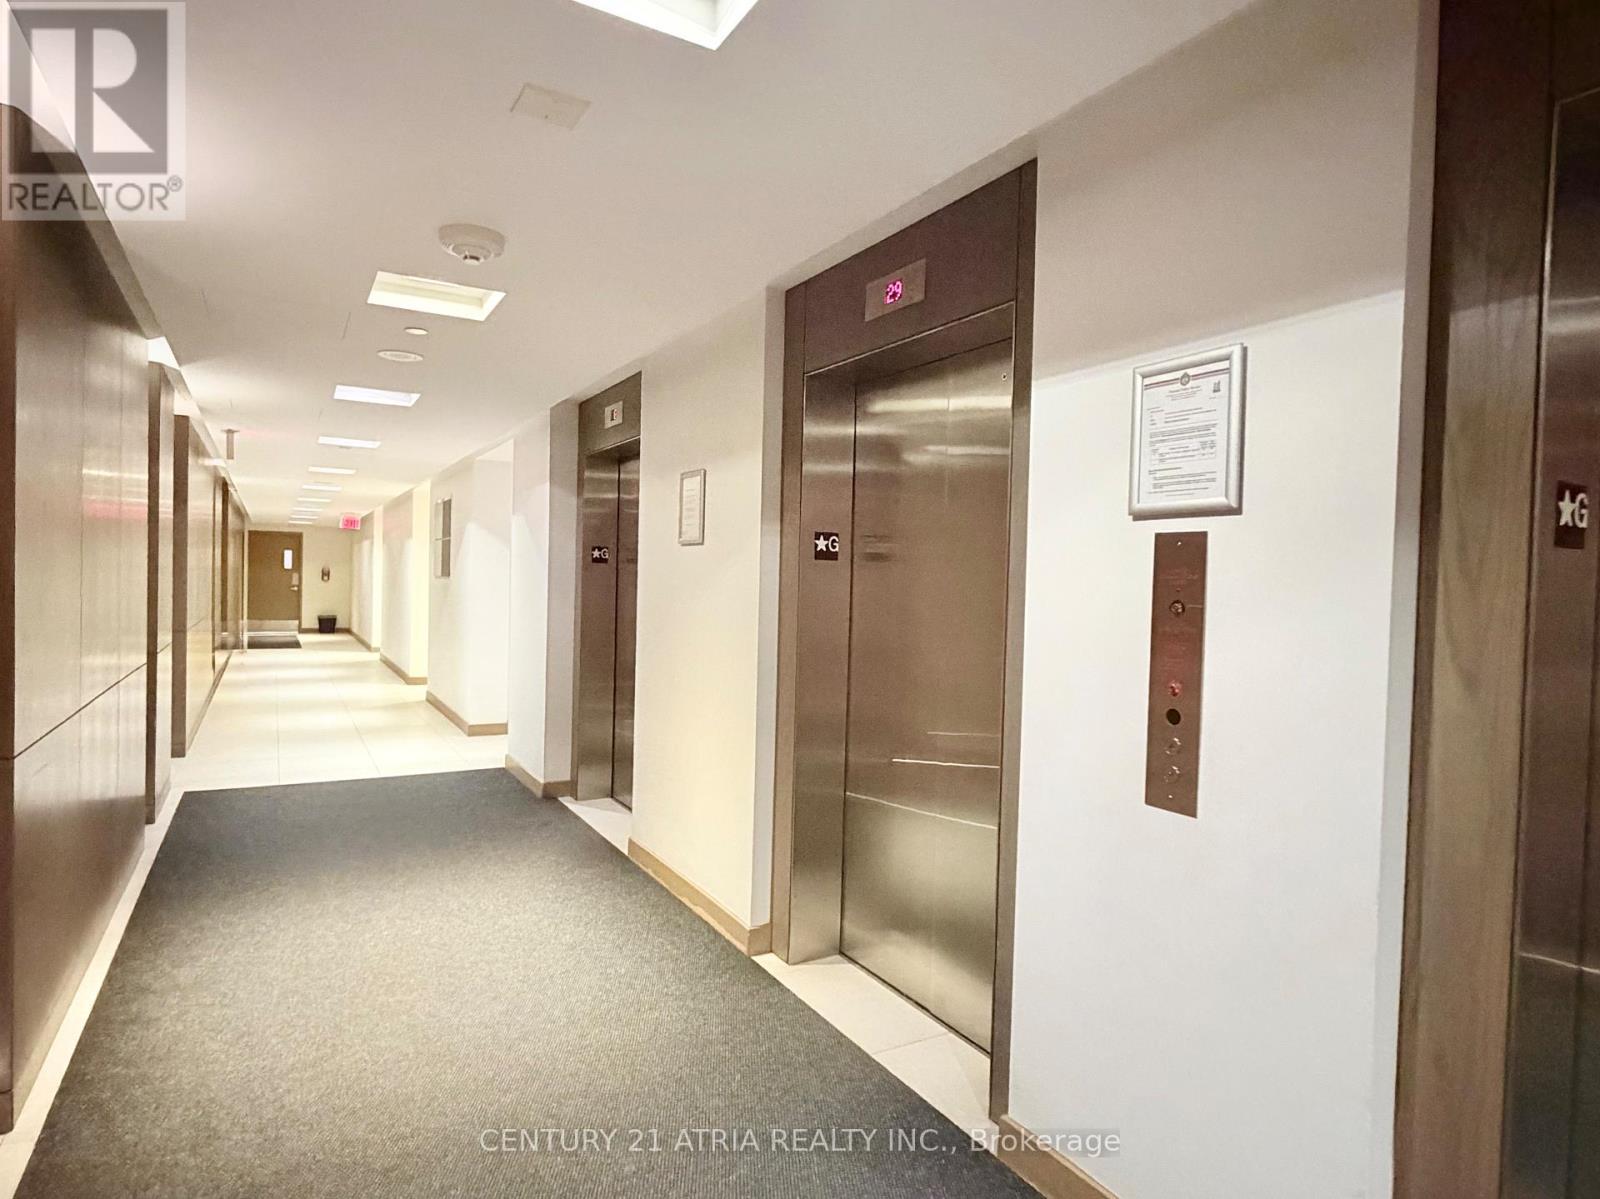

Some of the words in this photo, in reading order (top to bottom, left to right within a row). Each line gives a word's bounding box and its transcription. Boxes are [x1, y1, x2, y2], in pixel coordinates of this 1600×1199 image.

[884, 280, 903, 304] 29
[1574, 492, 1589, 529] G
[828, 535, 840, 552] G
